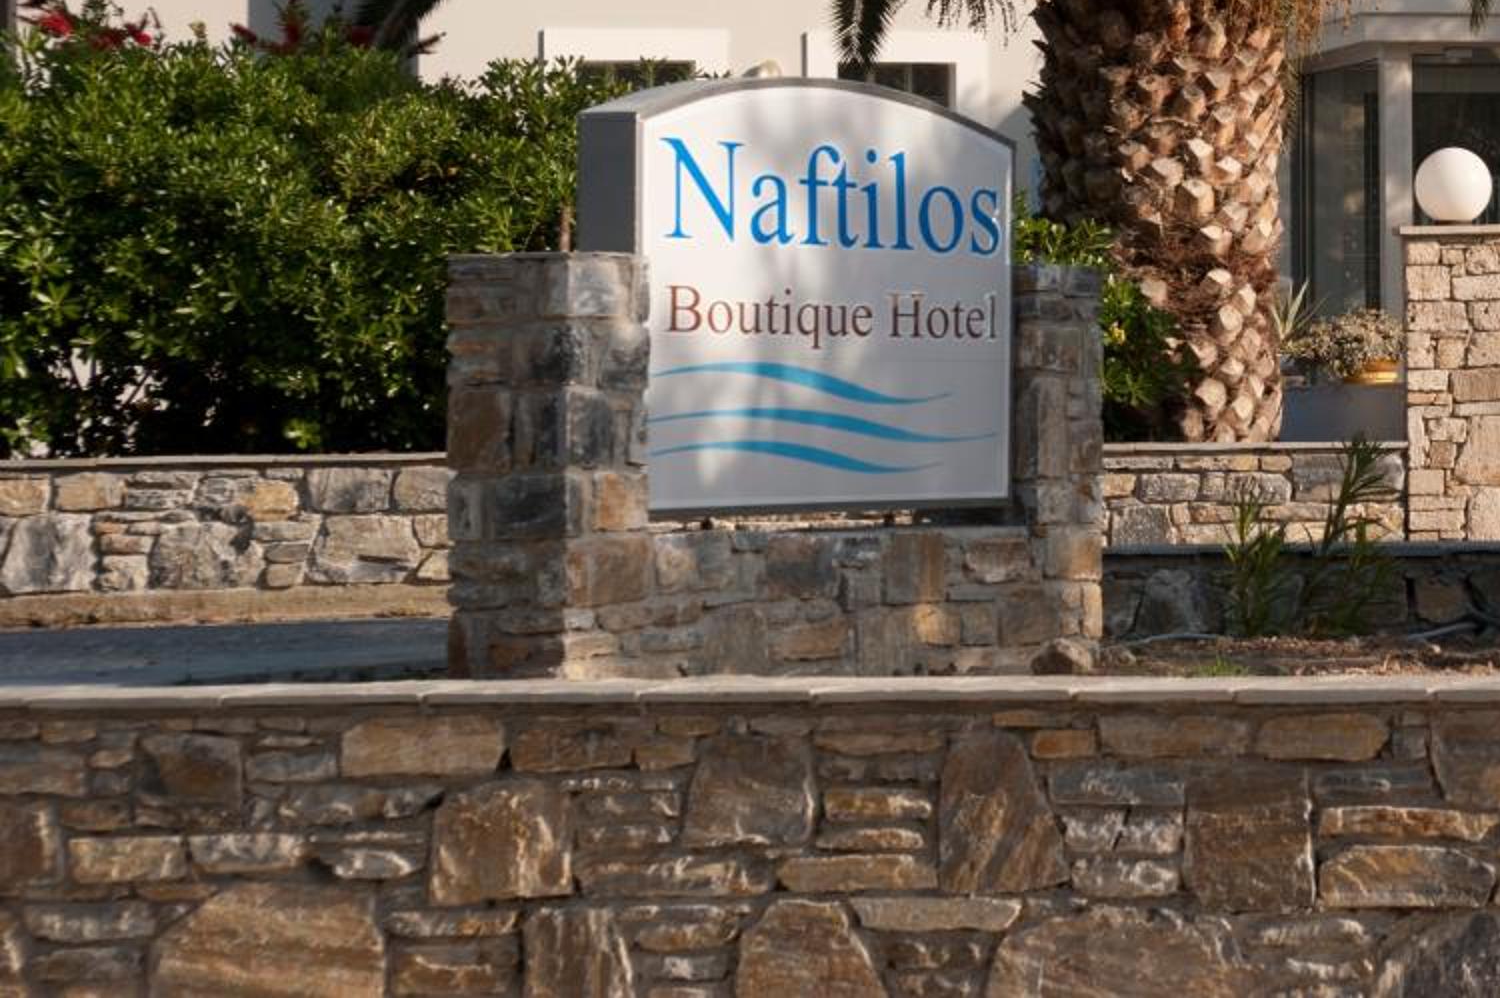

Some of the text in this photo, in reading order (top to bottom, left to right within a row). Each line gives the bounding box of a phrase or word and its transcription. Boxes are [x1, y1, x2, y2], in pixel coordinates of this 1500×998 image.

[660, 137, 1000, 256] Naftilos
[667, 285, 997, 349] Boutique Hotel
